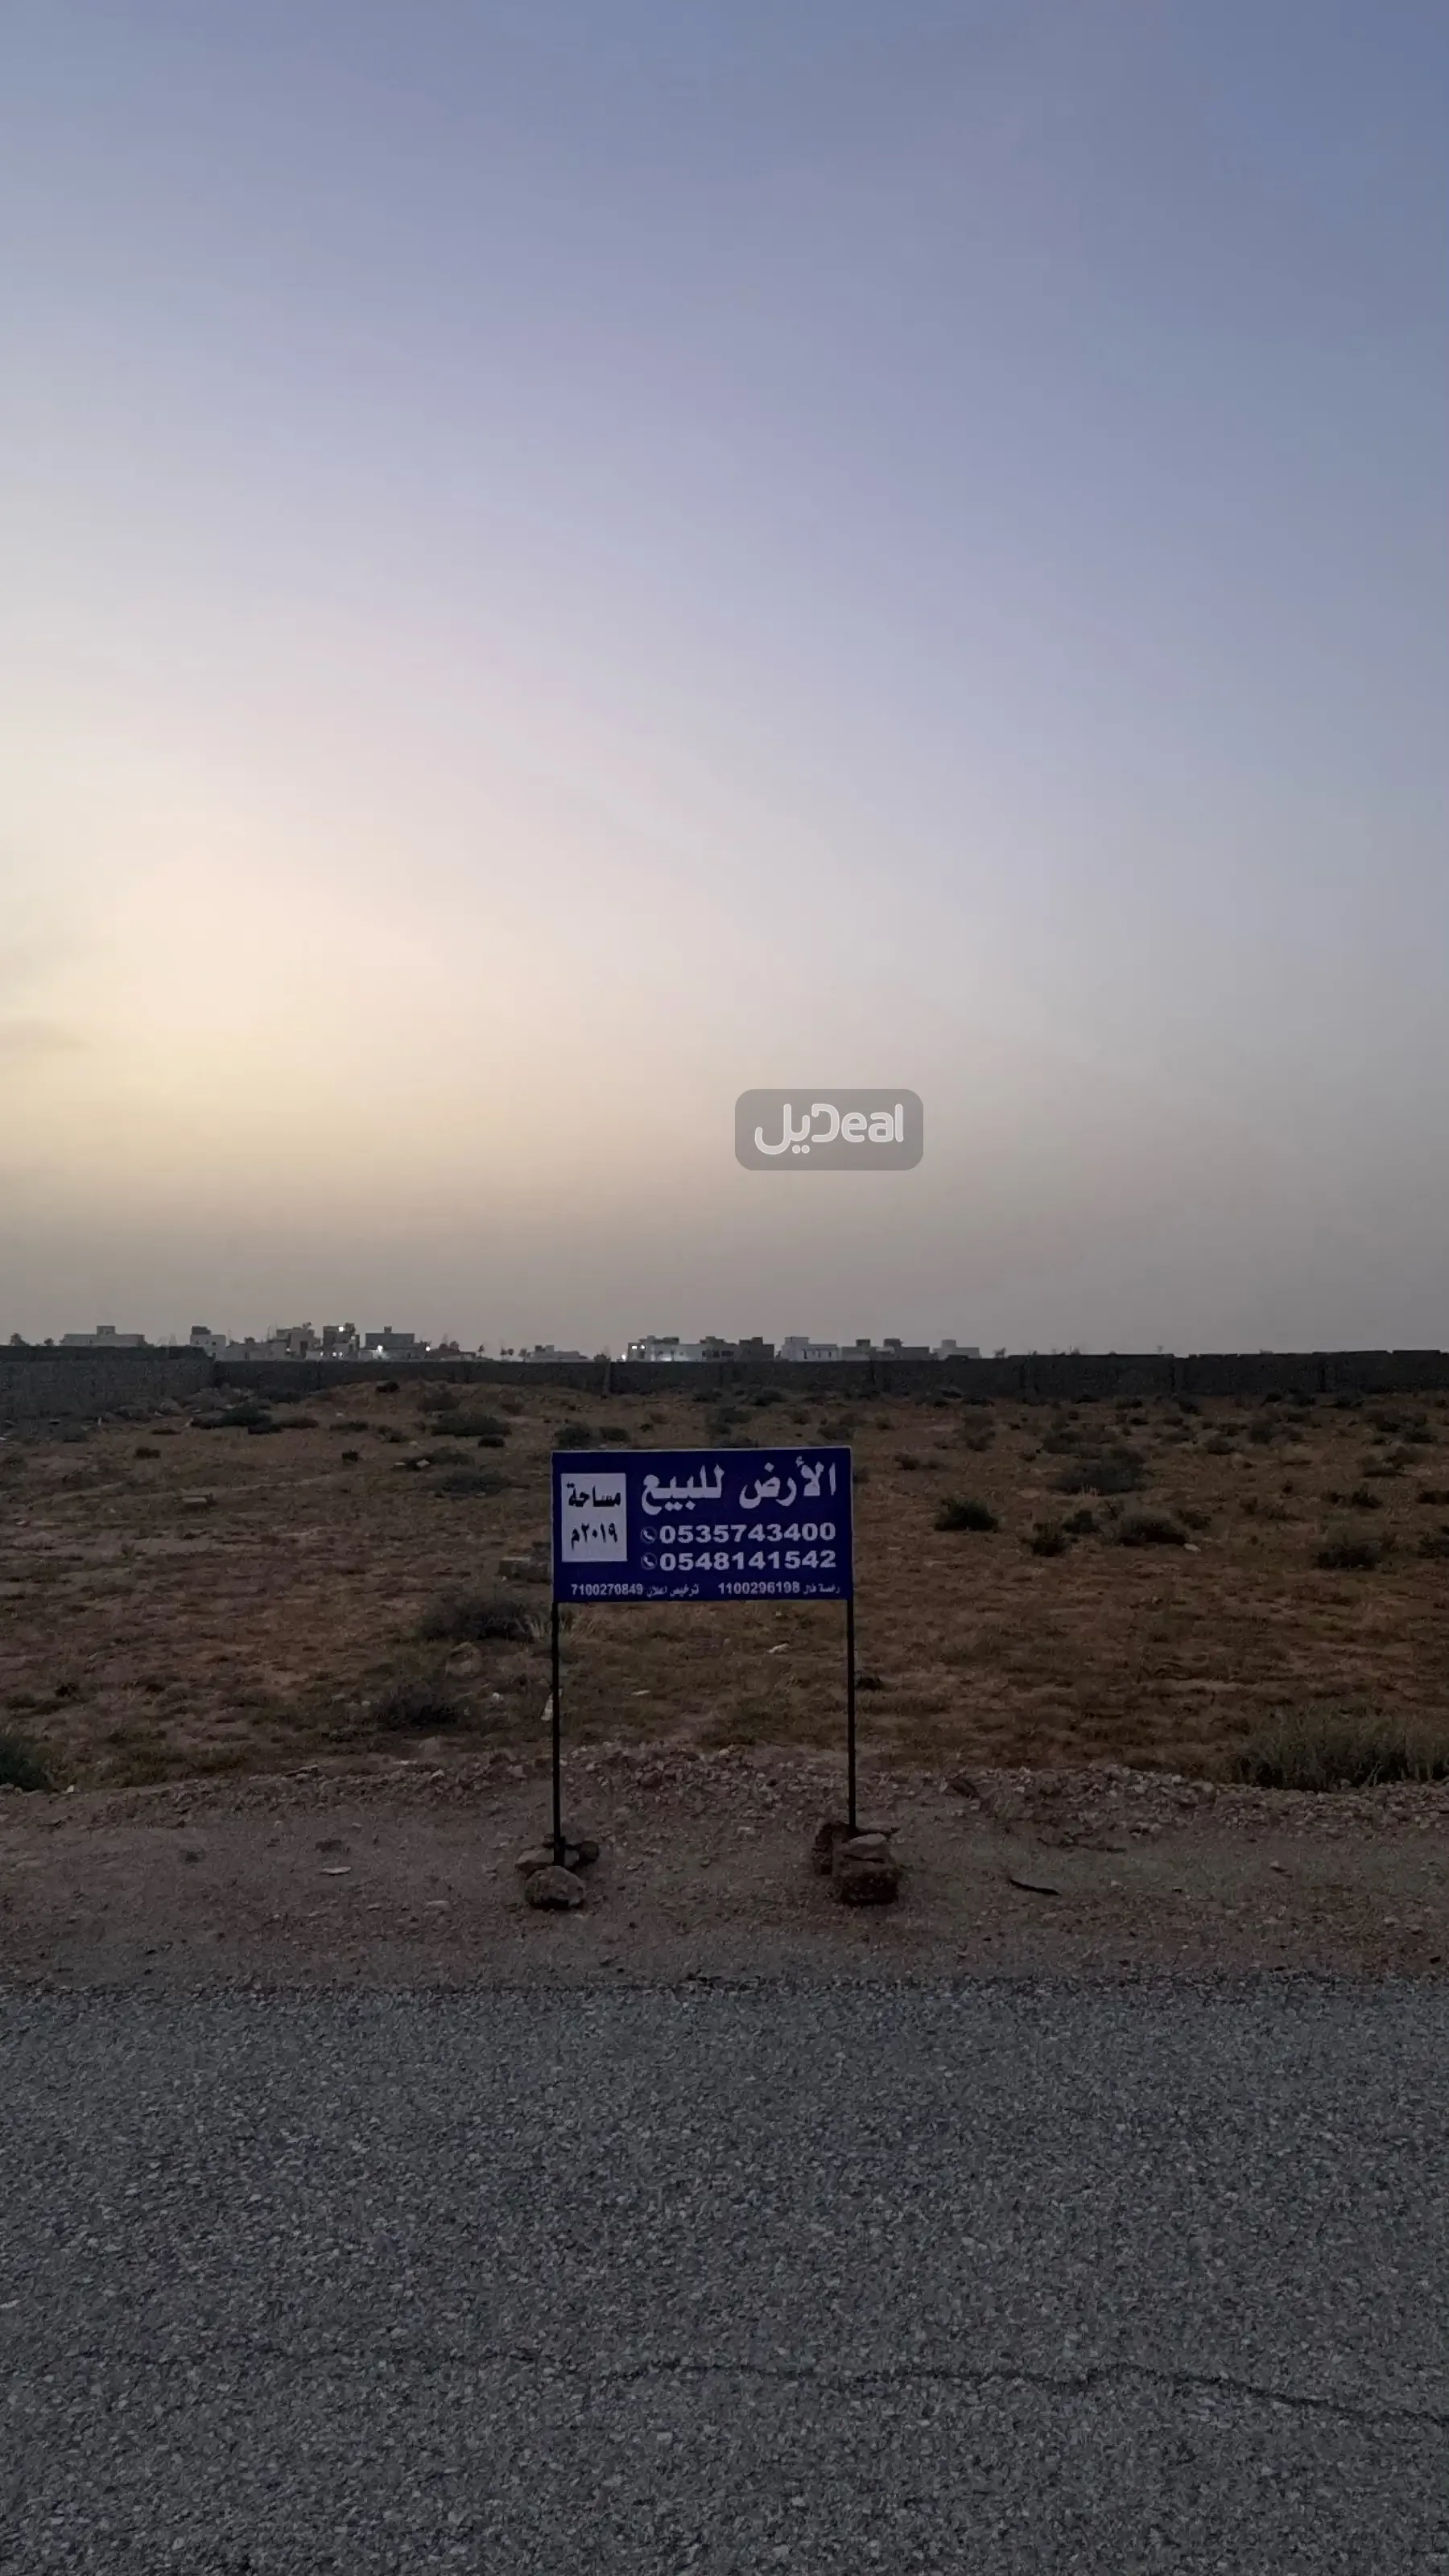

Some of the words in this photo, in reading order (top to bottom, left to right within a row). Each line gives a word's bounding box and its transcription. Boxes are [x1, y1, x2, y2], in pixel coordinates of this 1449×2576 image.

[566, 1481, 621, 1508] مساحة
[642, 1463, 724, 1515] للبيع
[739, 1455, 836, 1509] الأرض
[658, 1521, 836, 1544] 0535743400
[659, 1549, 837, 1571] 0548141542
